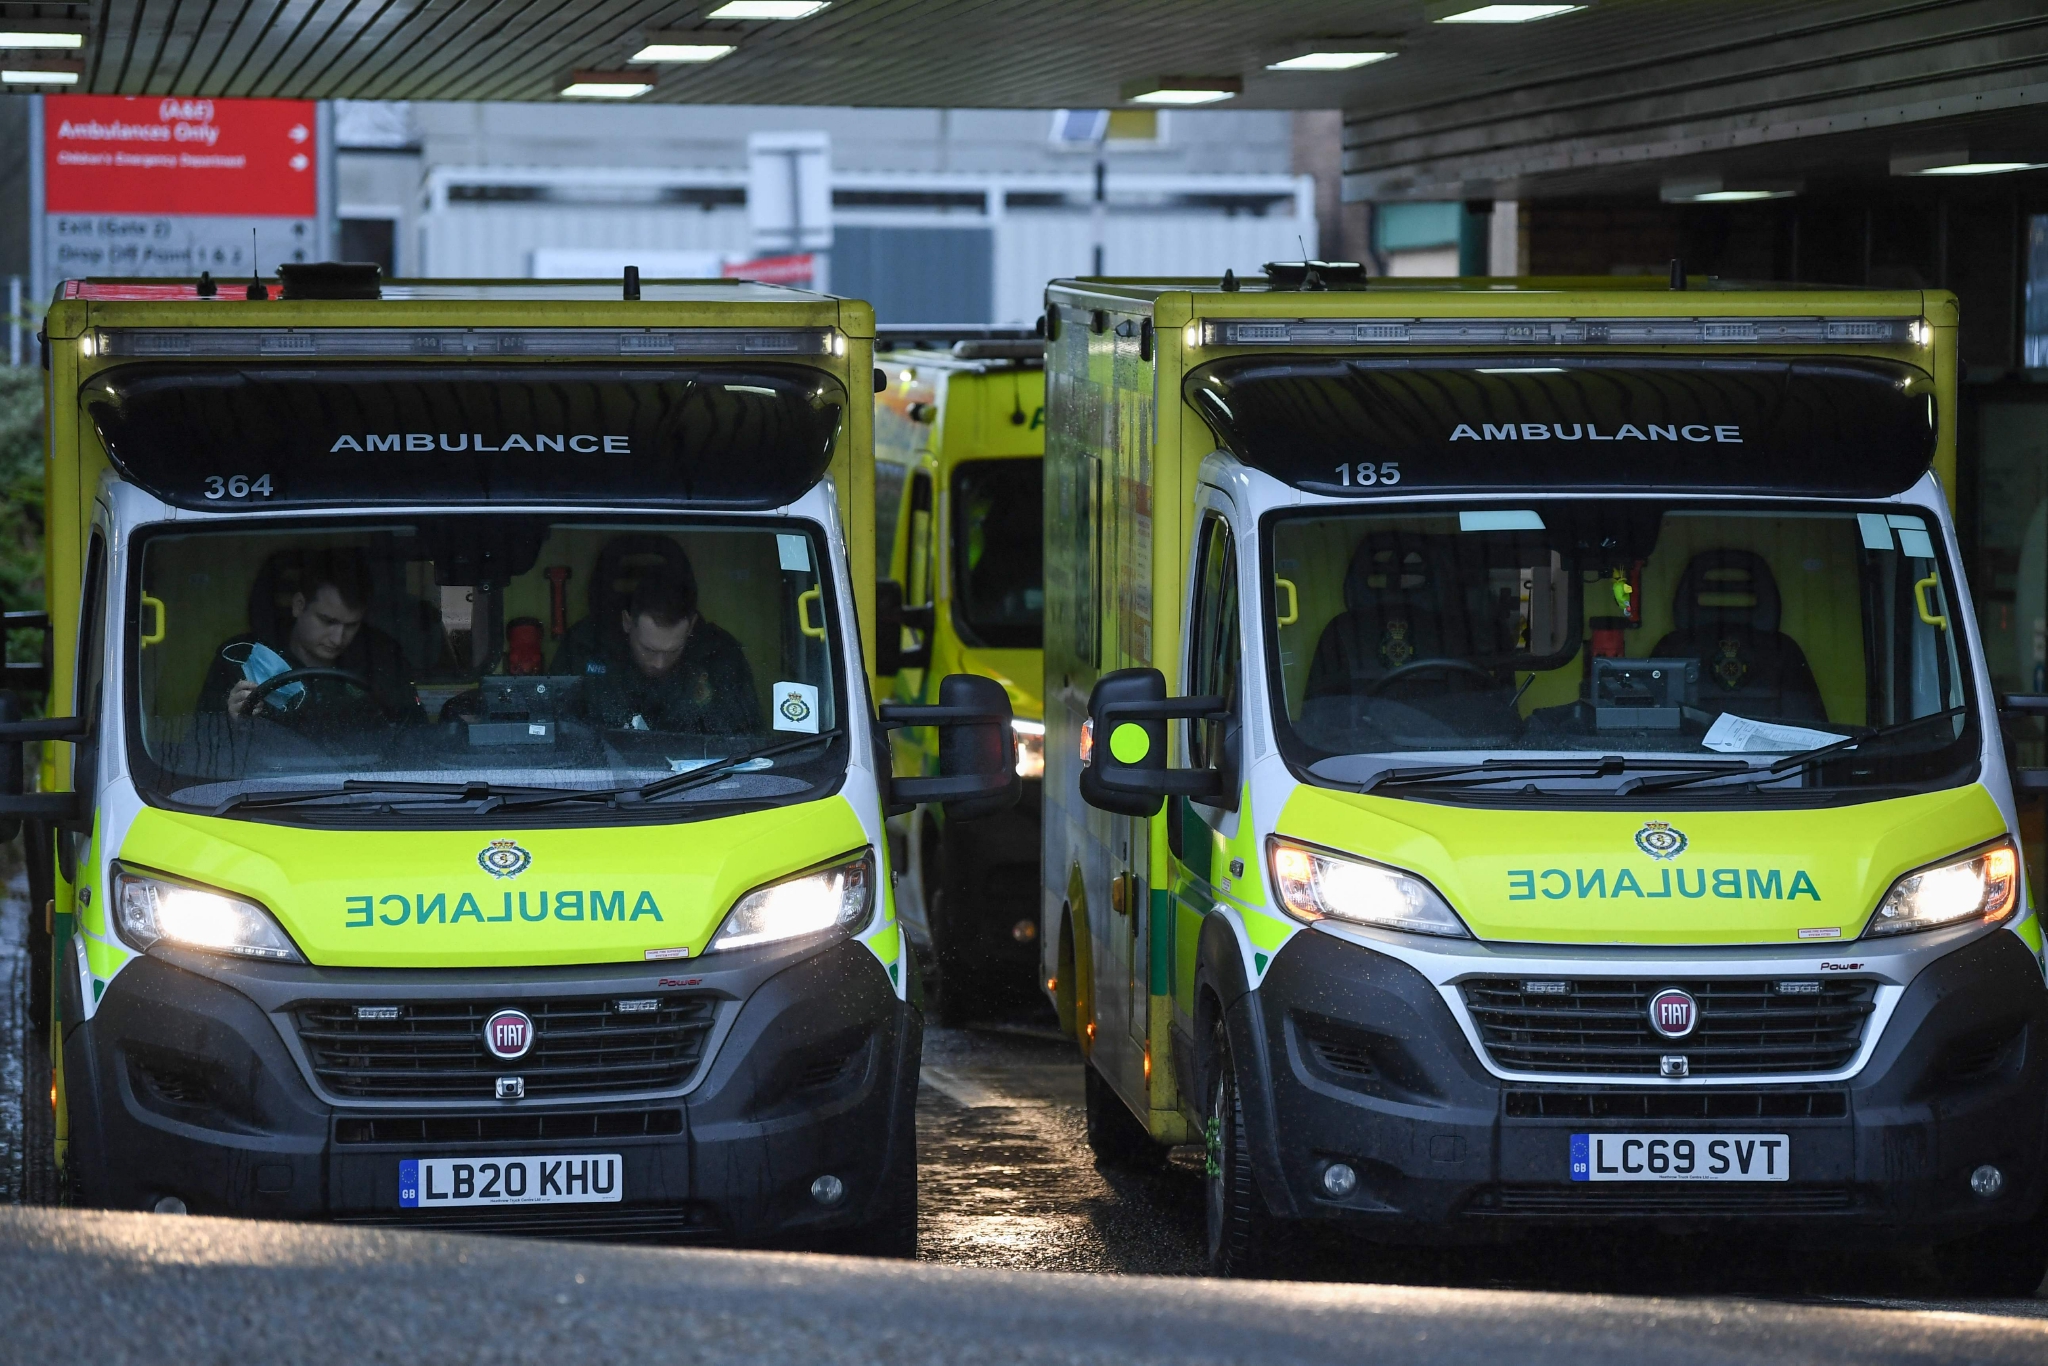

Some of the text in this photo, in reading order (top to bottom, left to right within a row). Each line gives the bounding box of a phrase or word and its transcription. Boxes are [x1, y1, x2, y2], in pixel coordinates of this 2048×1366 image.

[58, 120, 219, 146] Ambulances Only
[58, 218, 92, 236] Exit
[330, 433, 631, 454] AMBULANCE
[1449, 424, 1743, 443] AMBULANCE
[1335, 462, 1400, 486] 185
[203, 473, 274, 499] 364
[587, 664, 606, 674] NHS
[1820, 962, 1865, 971] Power
[658, 978, 703, 987] Power
[1661, 1003, 1689, 1025] FIAT
[496, 1024, 524, 1047] FIAT
[1596, 1139, 1781, 1175] LC69 SVT
[1573, 1163, 1587, 1173] GB
[426, 1160, 614, 1200] LB20 KHU
[402, 1189, 416, 1199] GB
